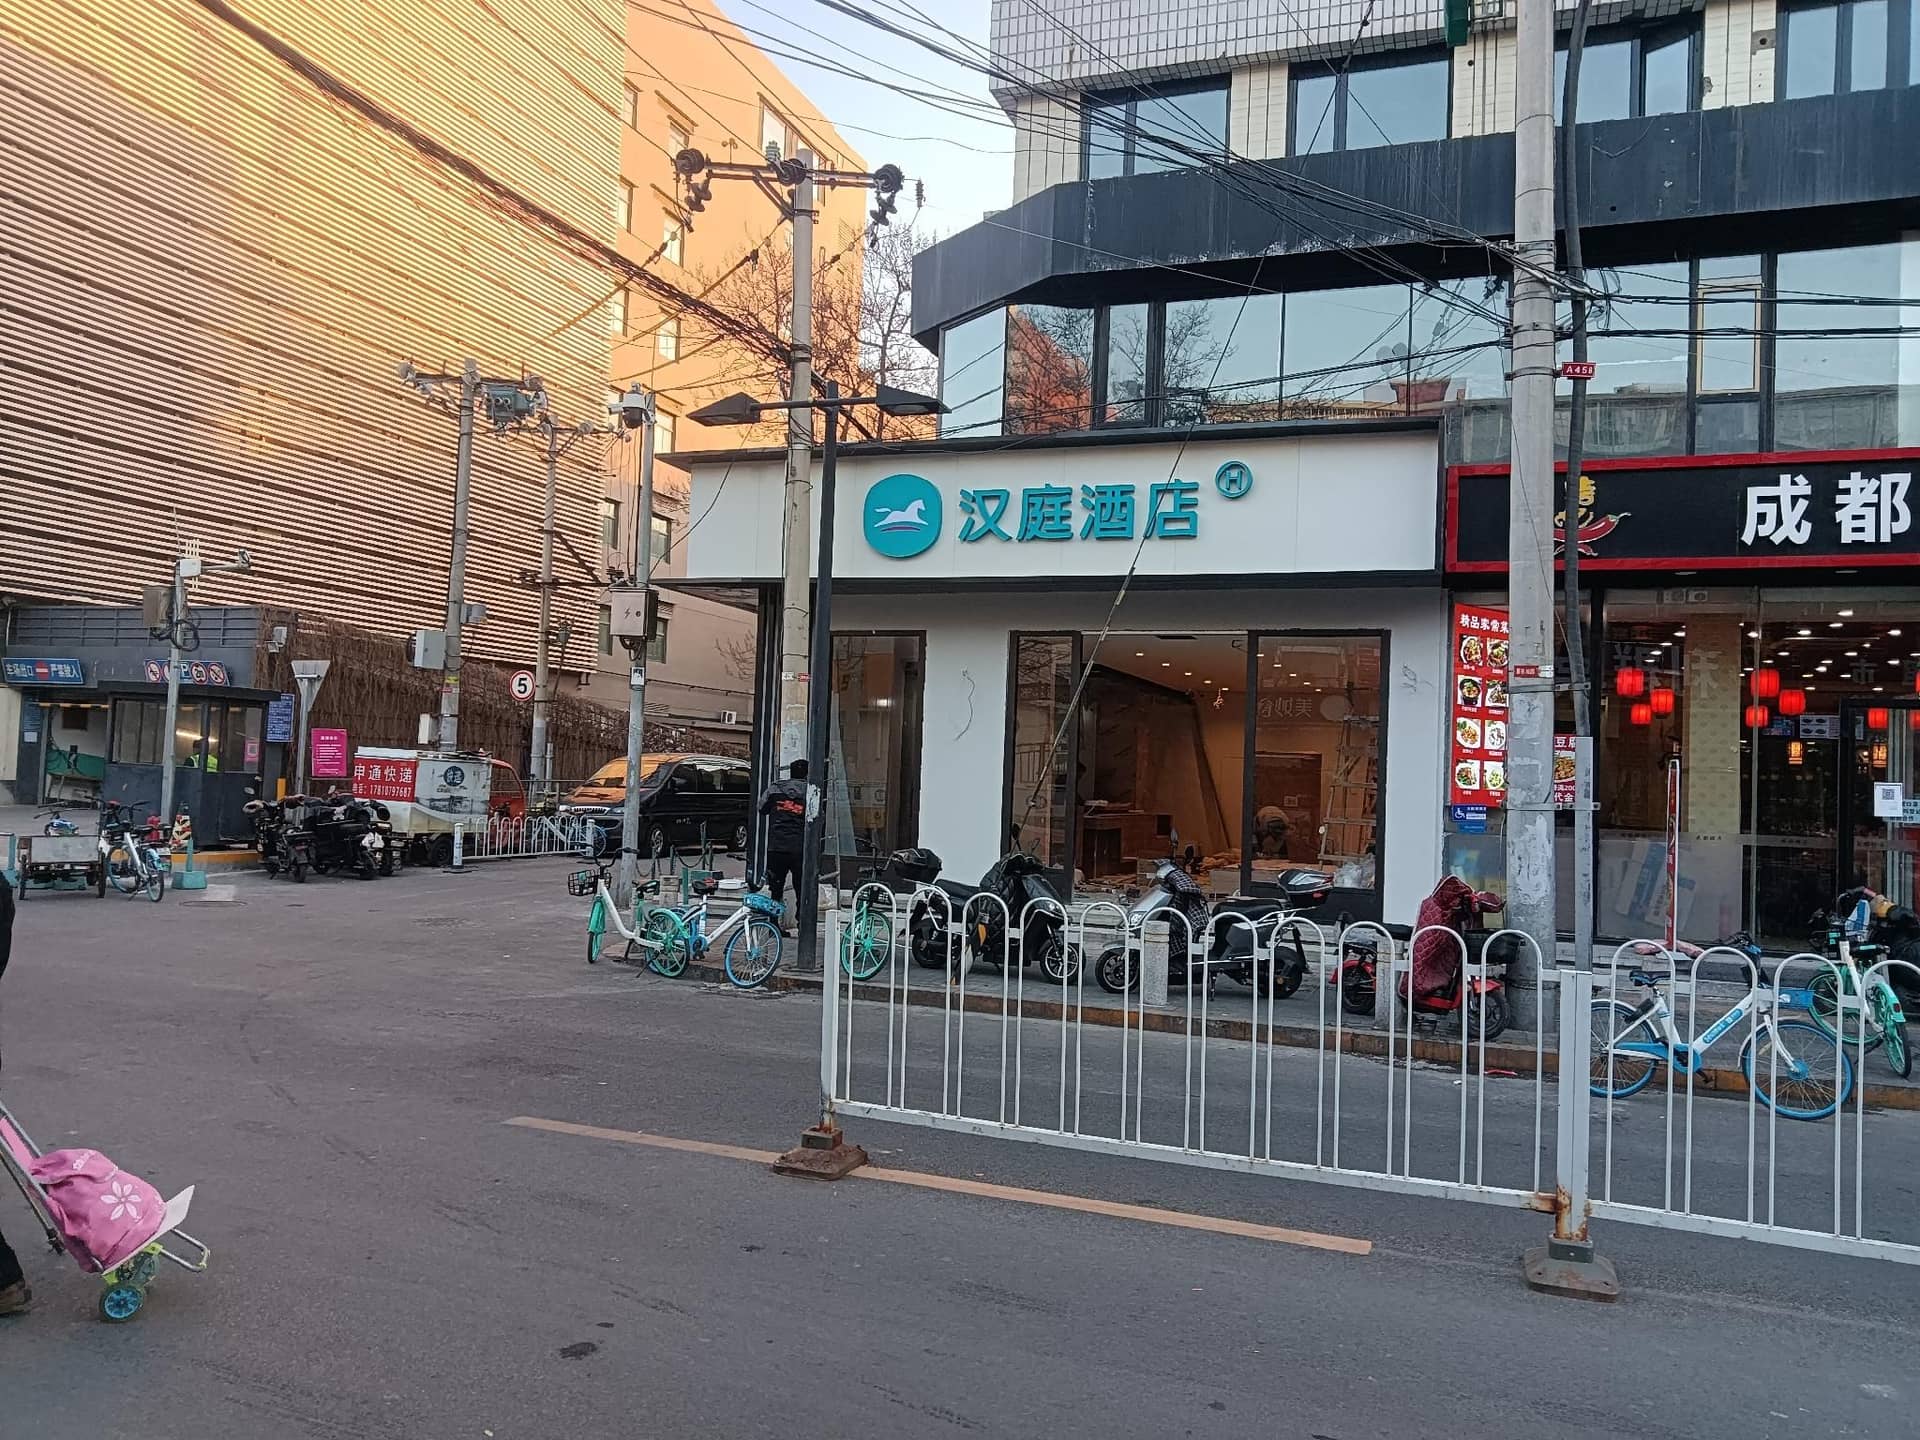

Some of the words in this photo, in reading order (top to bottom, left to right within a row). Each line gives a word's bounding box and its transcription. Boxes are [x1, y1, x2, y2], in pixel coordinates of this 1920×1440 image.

[958, 478, 1200, 542] 汉庭酒店
[1741, 472, 1913, 546] 成都
[517, 678, 527, 694] 5
[354, 764, 413, 784] 申通快递
